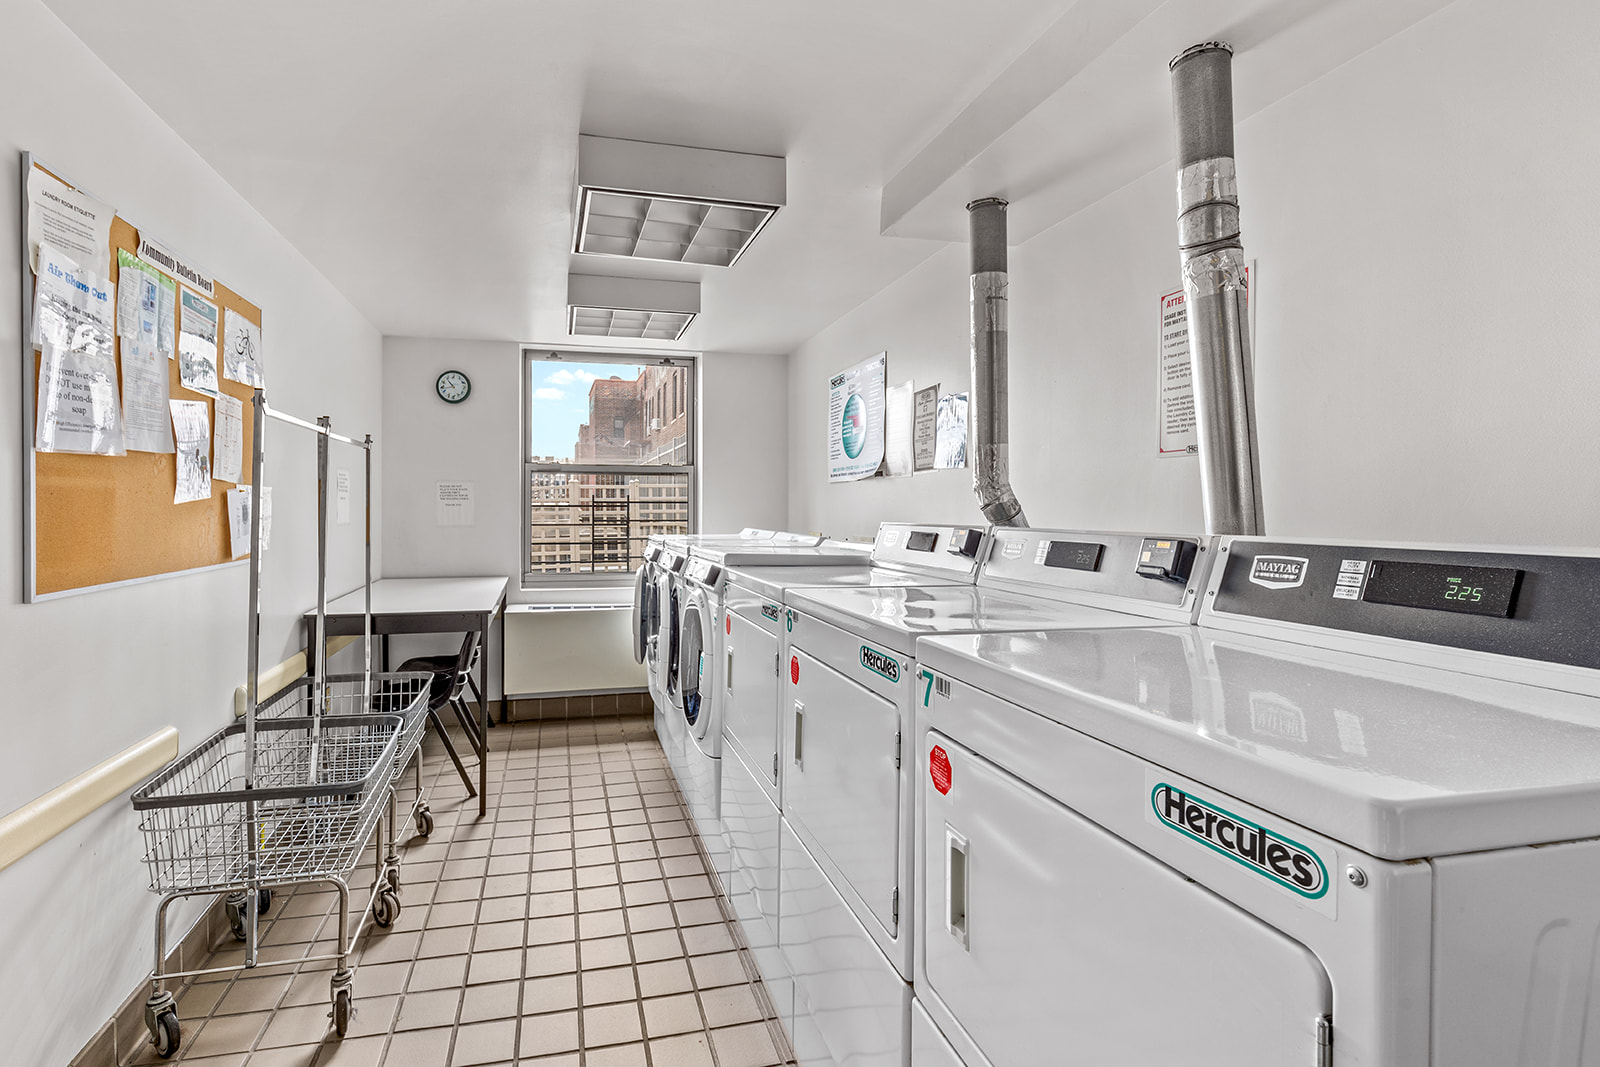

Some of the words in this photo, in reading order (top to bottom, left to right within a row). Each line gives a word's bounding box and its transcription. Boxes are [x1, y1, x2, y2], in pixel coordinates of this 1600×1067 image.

[42, 189, 60, 203] LAUNDRY
[61, 199, 73, 210] ROOM
[74, 204, 96, 220] ETIQUETTE
[47, 262, 63, 278] Air
[91, 287, 107, 302] Out
[176, 260, 197, 284] Bulletin
[1172, 316, 1187, 325] MAYTA
[63, 391, 71, 400] of
[72, 382, 83, 390] use
[72, 406, 87, 416] soap
[1256, 562, 1301, 575] MAYTAG
[1444, 585, 1484, 602] 2.25
[787, 609, 793, 633] 6
[862, 646, 898, 679] Hercules
[922, 669, 934, 708] 7
[934, 748, 947, 759] STOP
[1163, 785, 1314, 888] Hercules
